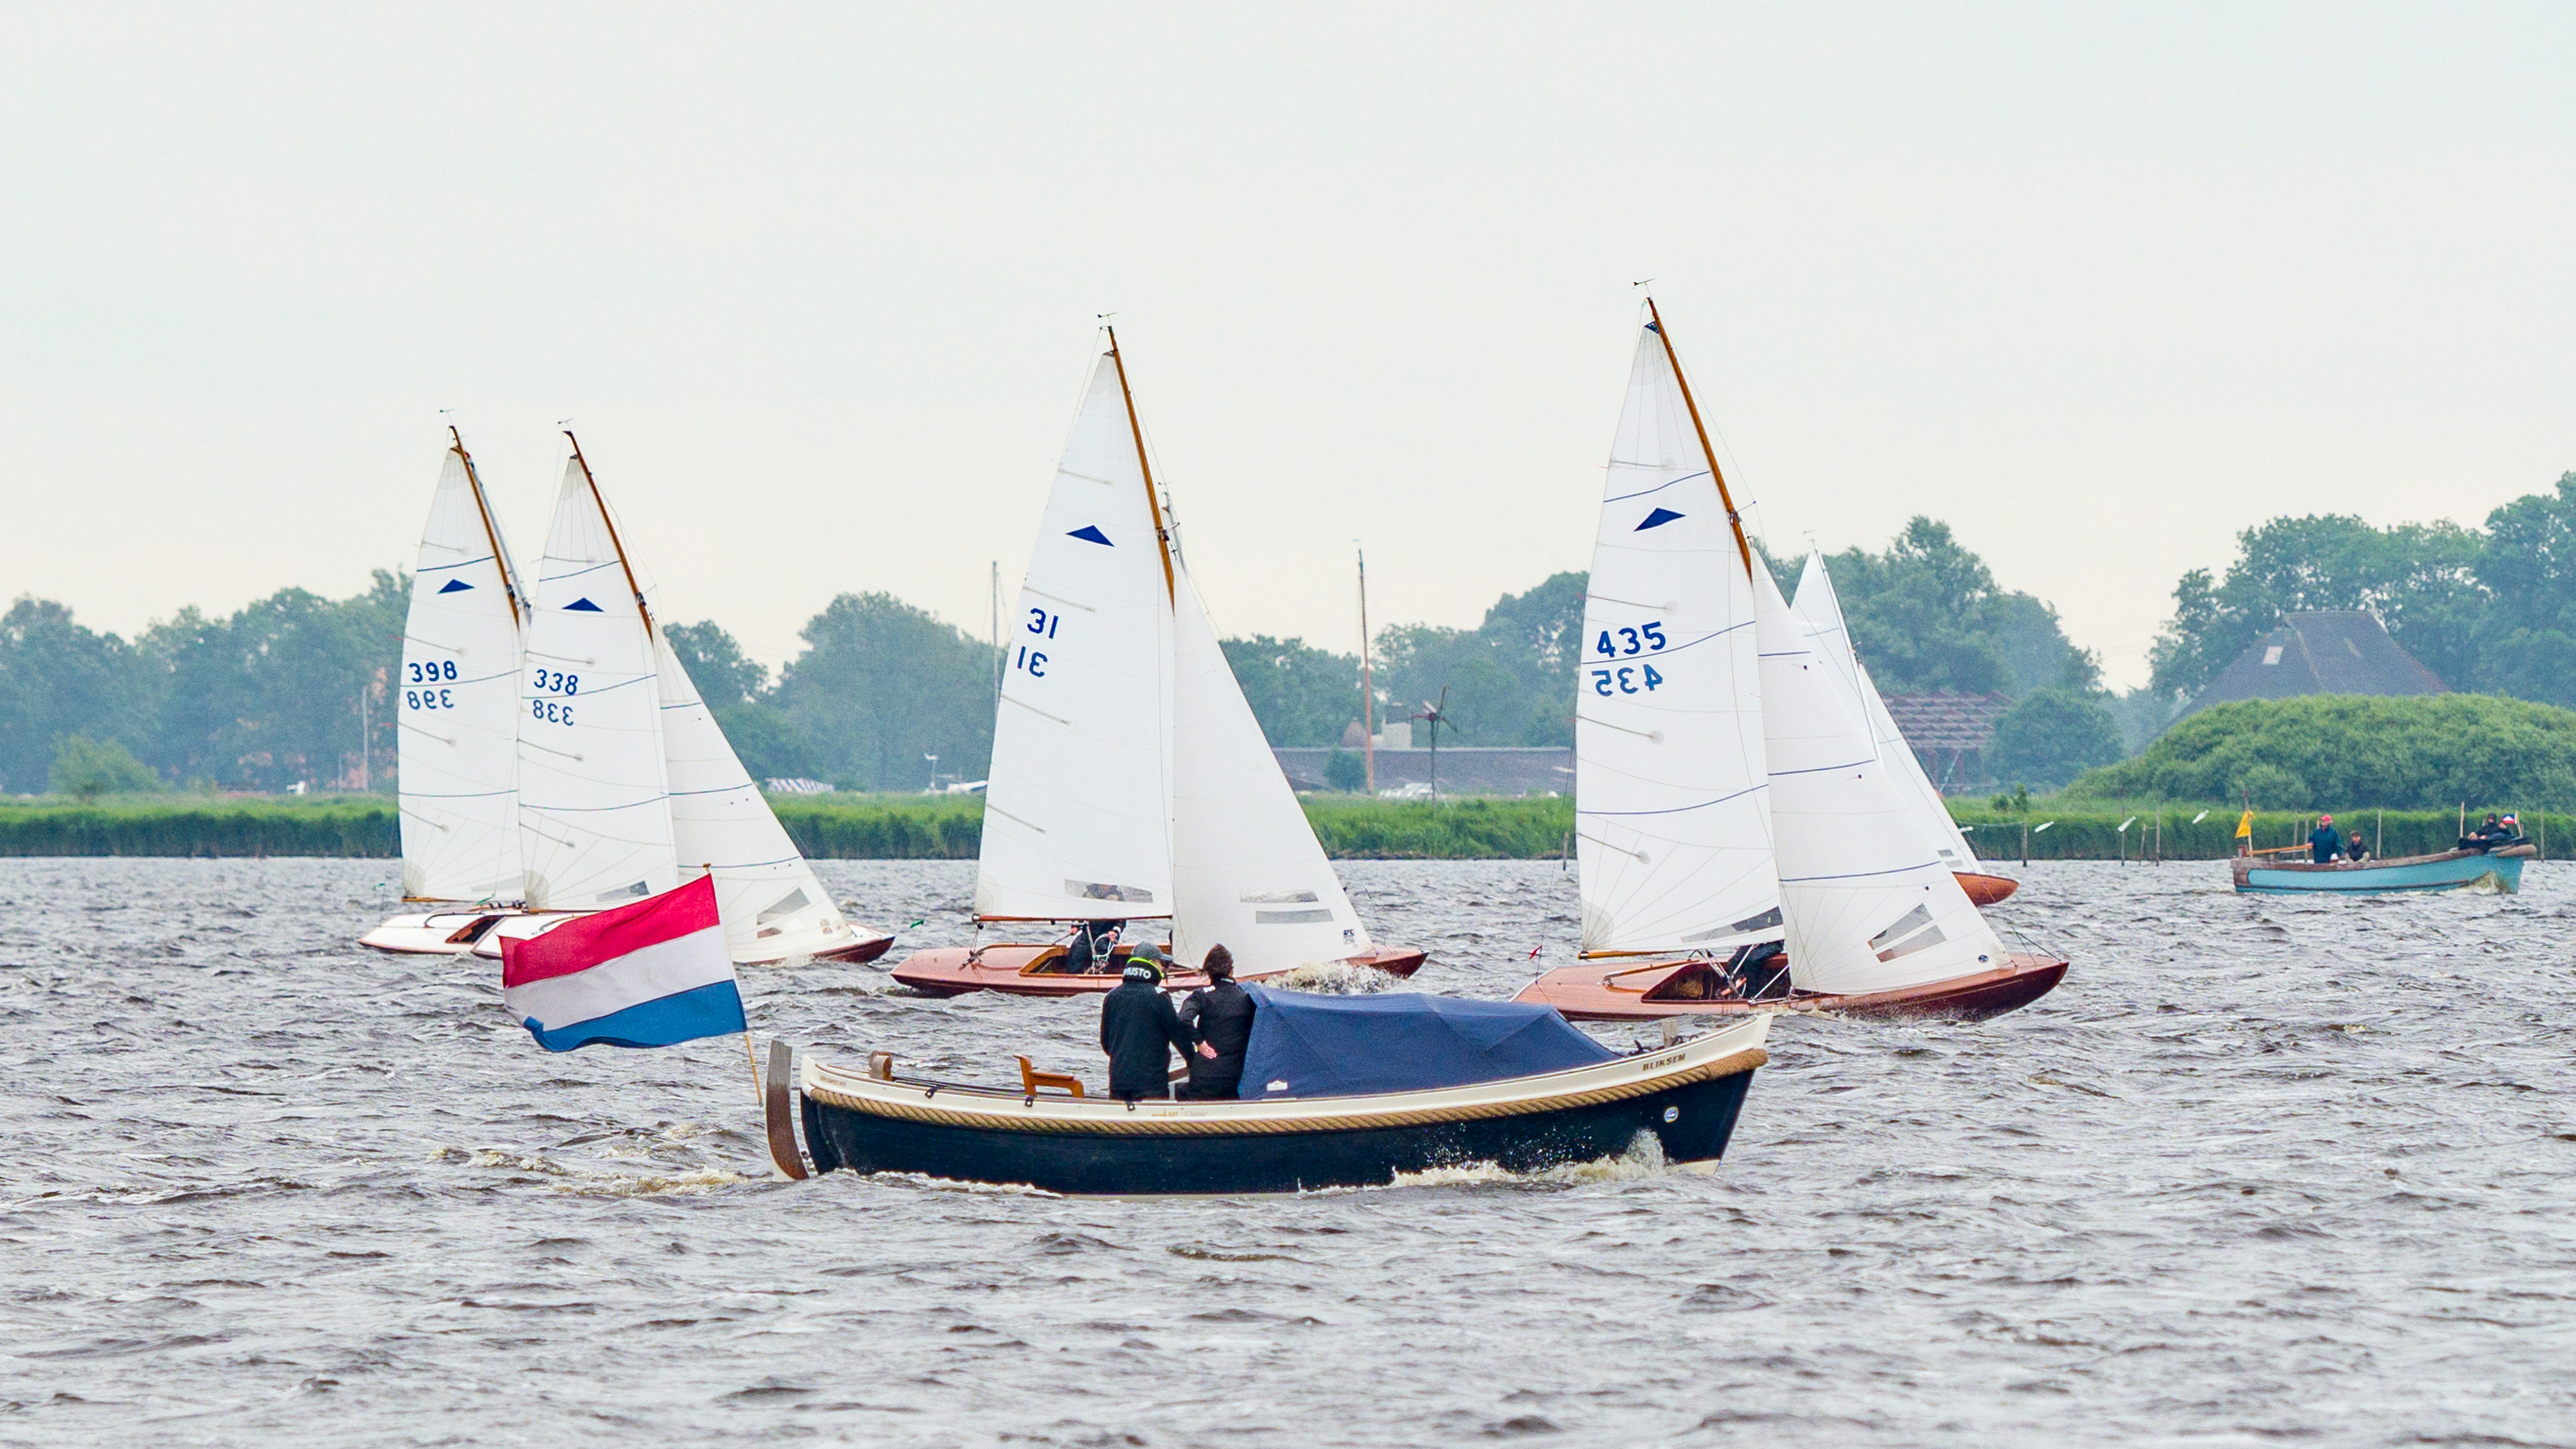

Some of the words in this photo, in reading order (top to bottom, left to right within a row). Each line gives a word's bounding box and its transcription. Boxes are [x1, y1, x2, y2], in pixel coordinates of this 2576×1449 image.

[1026, 607, 1059, 640] 31
[1597, 621, 1667, 659] 435
[408, 660, 458, 683] 398
[533, 668, 579, 697] 338
[1642, 1053, 1686, 1070] BLIKSEM
